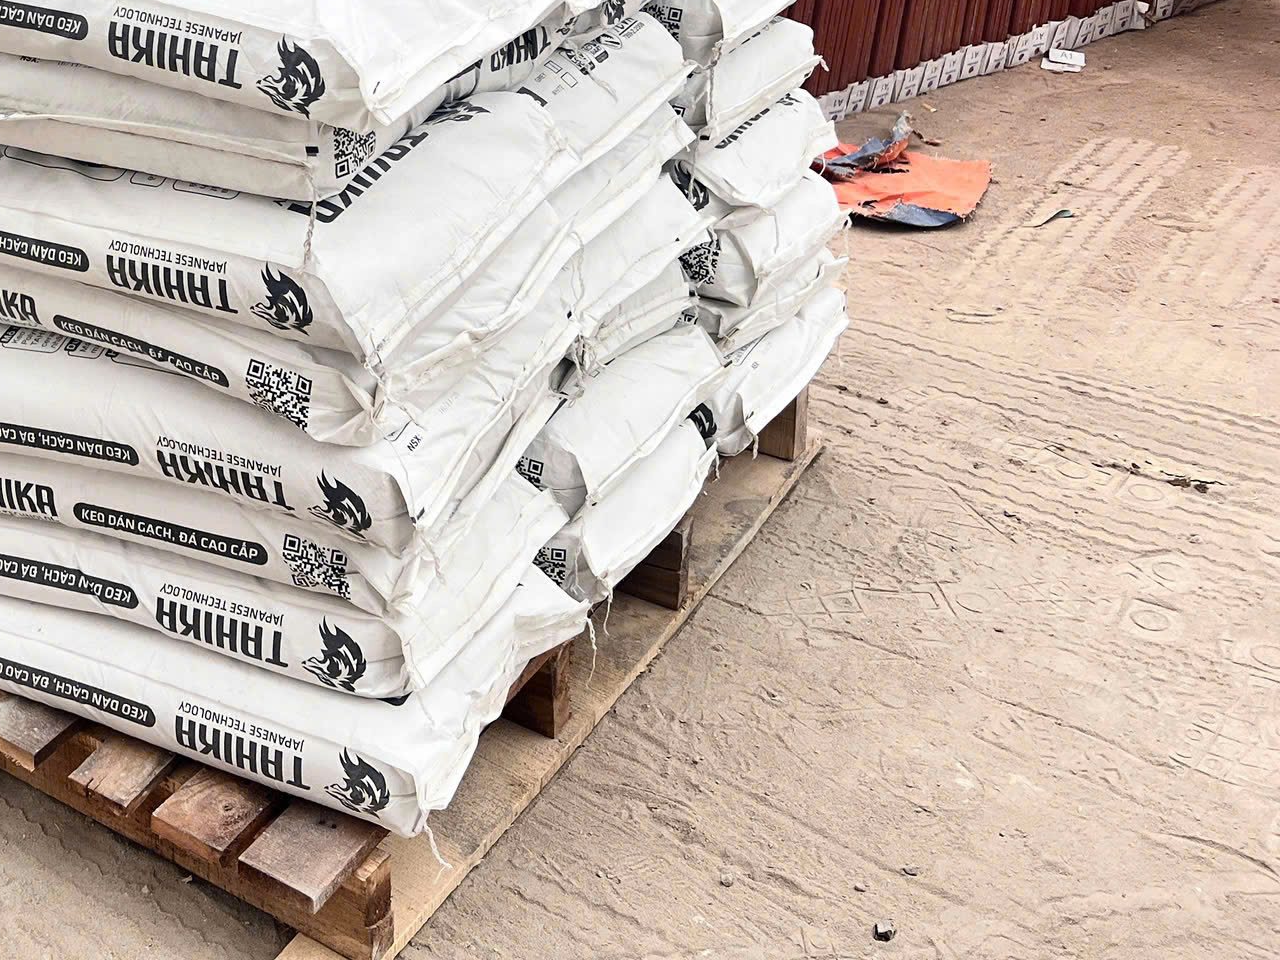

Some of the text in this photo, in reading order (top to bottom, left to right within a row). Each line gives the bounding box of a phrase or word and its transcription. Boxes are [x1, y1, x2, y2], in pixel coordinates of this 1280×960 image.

[26, 11, 54, 28] DÁN
[57, 17, 82, 34] KEO
[113, 6, 242, 44] JAPANESE TECHNOLOGY
[108, 21, 242, 89] TAHIKA
[30, 244, 56, 261] DÁN
[58, 250, 82, 266] KEO
[109, 240, 227, 274] JAPANESE TECHNOLOGY
[106, 254, 238, 314] TAHIKA
[60, 320, 220, 383] KEO DÁN CAO CẤP
[18, 429, 36, 444] ĐÁ
[76, 439, 104, 457] DÁN
[106, 445, 131, 461] KEO
[156, 435, 282, 477] JAPANESE TECHNOLOGY
[80, 508, 105, 524] KEO
[108, 512, 135, 530] DÁN
[178, 530, 198, 546] ĐÁ
[200, 538, 227, 553] CAO
[229, 541, 259, 560] CẤP
[20, 563, 38, 580] ĐÁ
[104, 587, 132, 603] KEO
[159, 583, 283, 627] JAPANESE TECHNOLOGY
[155, 597, 288, 668] TAHIKA
[5, 665, 29, 681] CAO
[31, 672, 50, 689] ĐÁ
[92, 693, 120, 713] DÁN
[121, 704, 148, 721] KEO
[178, 700, 305, 753] JAPANESE TECHNOLOGY
[175, 715, 311, 791] TAHIKA
